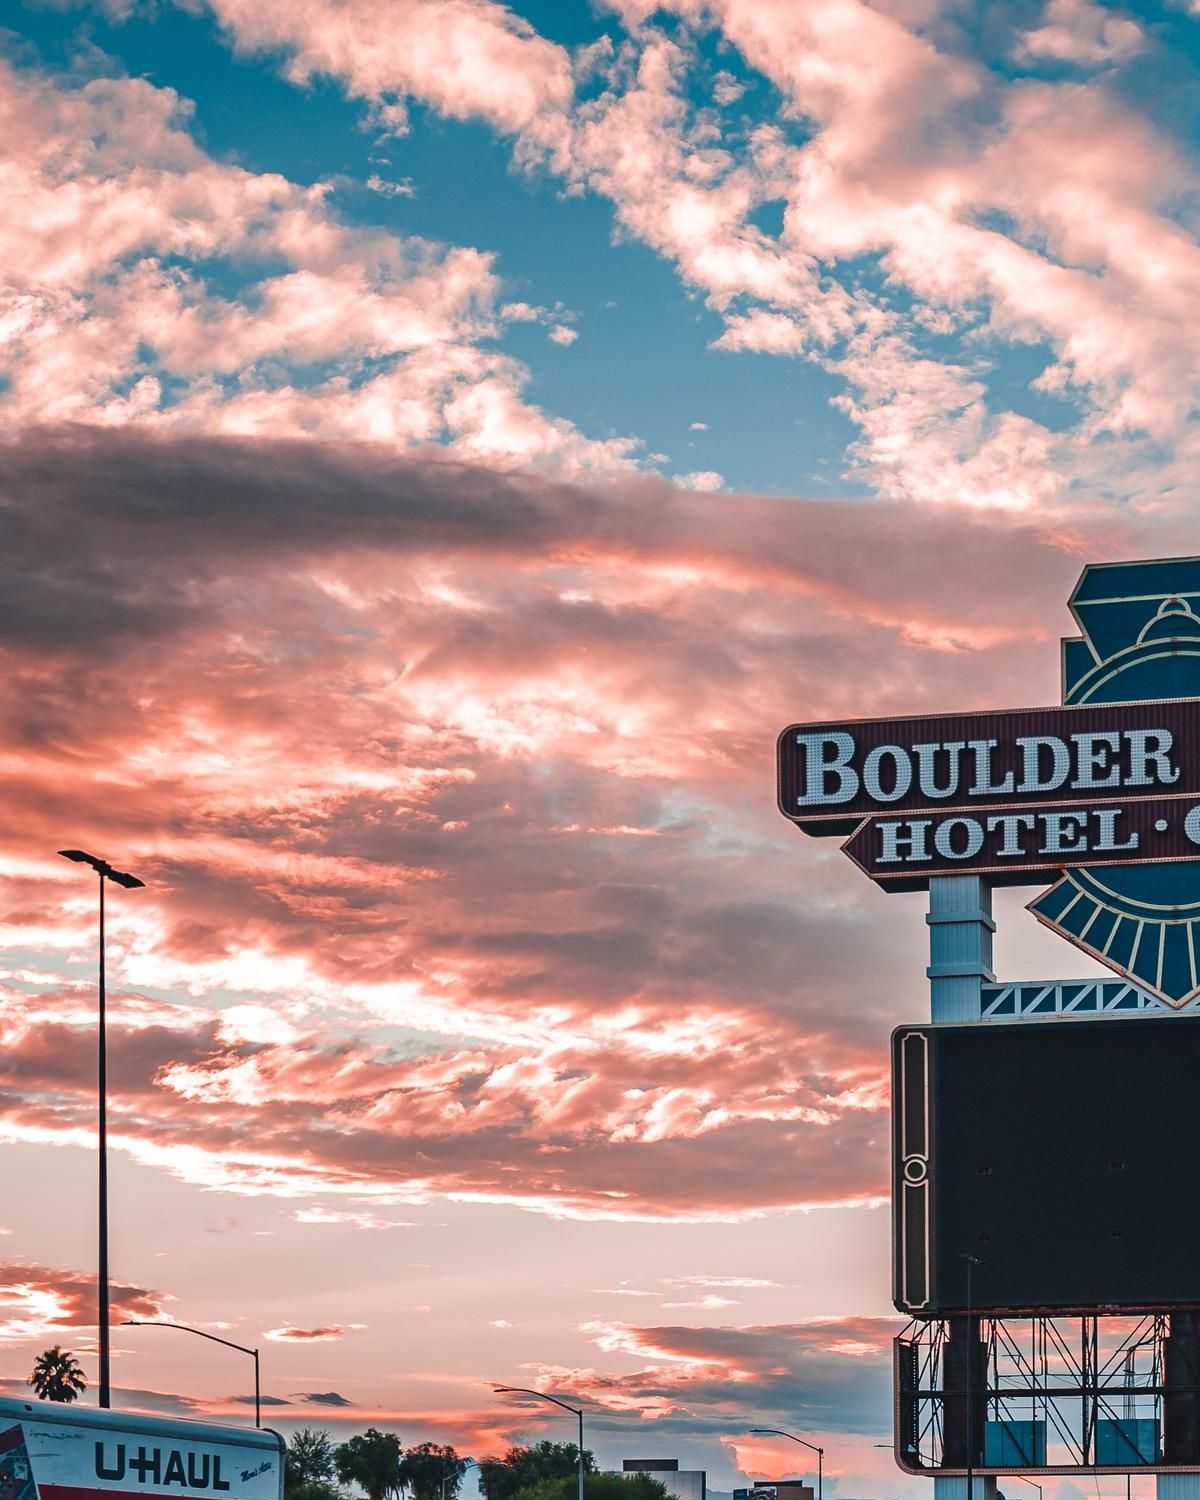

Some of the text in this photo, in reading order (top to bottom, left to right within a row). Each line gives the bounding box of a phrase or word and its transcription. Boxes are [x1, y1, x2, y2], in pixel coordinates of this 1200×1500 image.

[796, 728, 1180, 806] BOULDER
[874, 809, 1139, 863] HOTEL
[95, 1441, 230, 1491] U-HAUL
